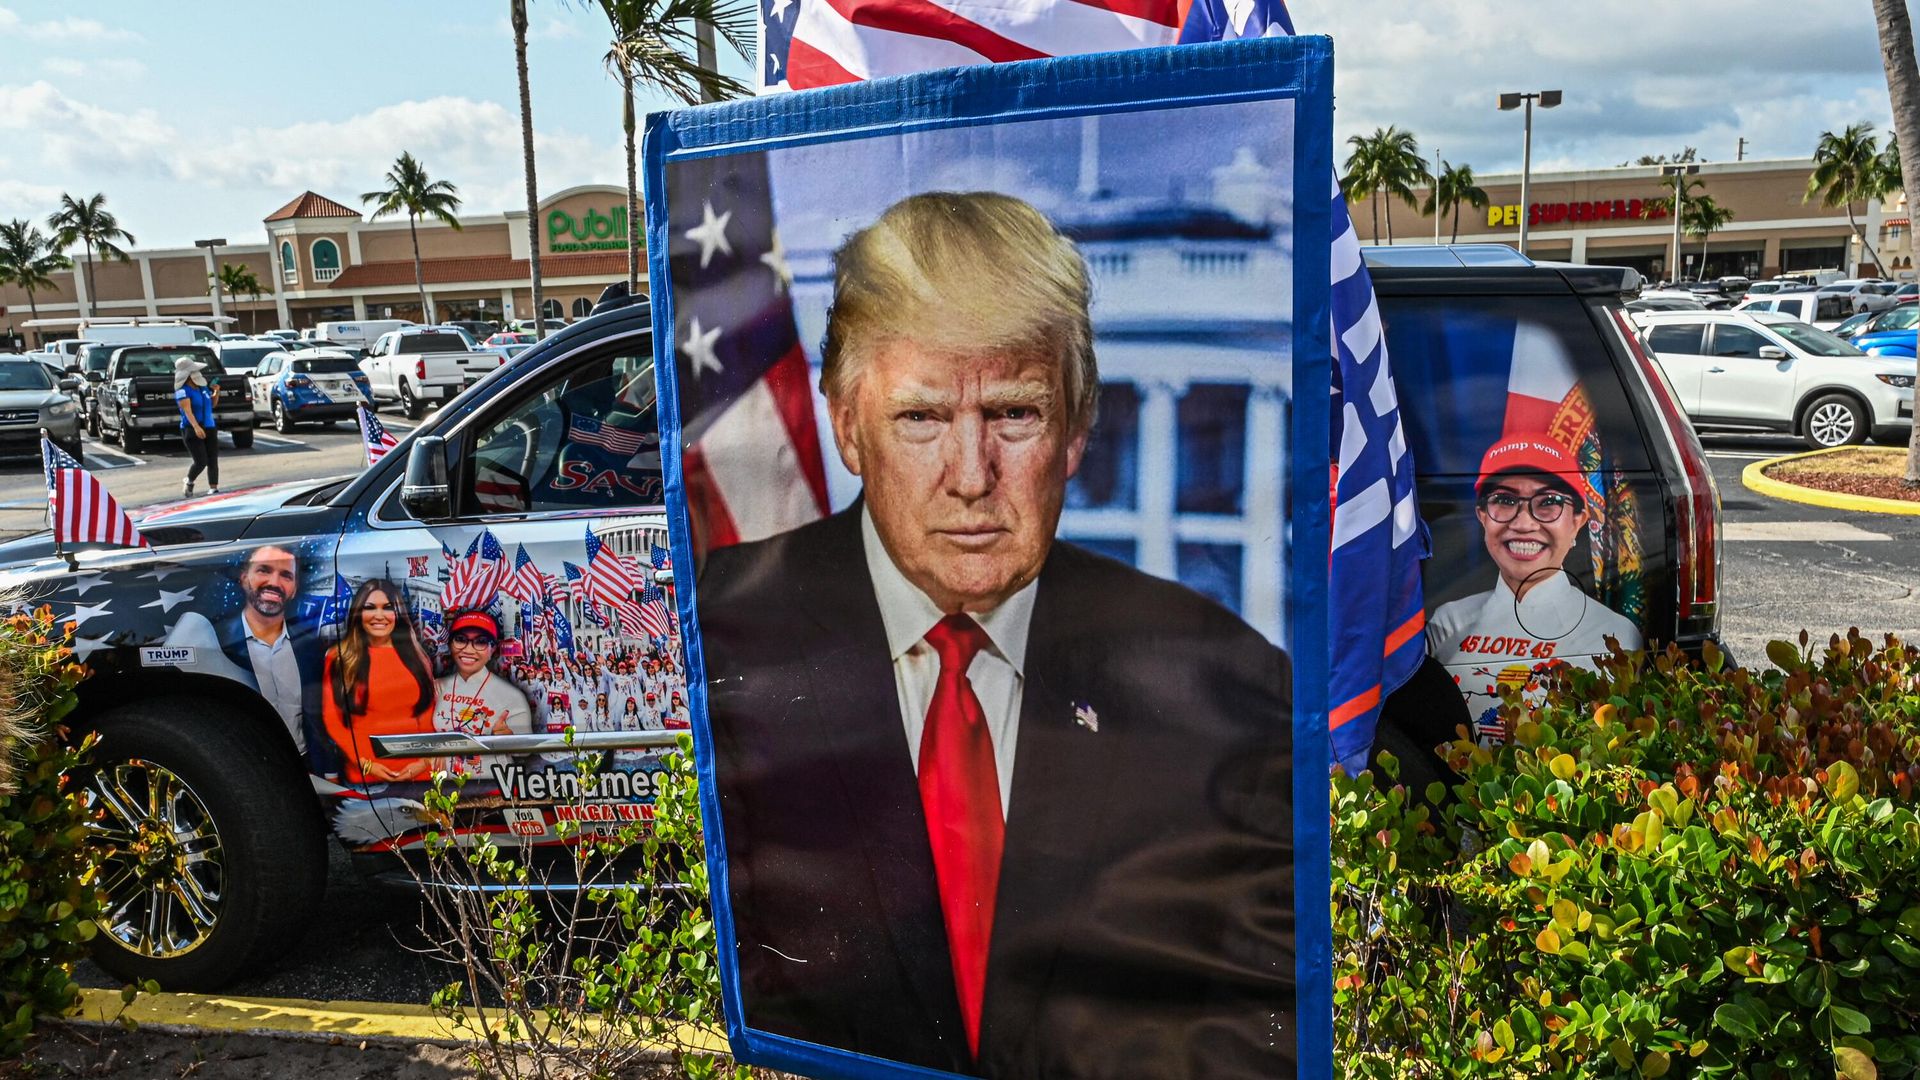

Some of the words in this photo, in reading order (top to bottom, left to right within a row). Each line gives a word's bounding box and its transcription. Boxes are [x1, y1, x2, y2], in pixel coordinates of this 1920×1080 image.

[1530, 199, 1677, 225] SUPERMAR
[1489, 441, 1529, 459] Trump
[1532, 442, 1562, 460] won.
[549, 460, 663, 504] SAV
[147, 650, 189, 659] TRUMP
[1460, 635, 1482, 653] 45
[1479, 636, 1531, 657] LOVE
[1530, 641, 1557, 659] 45
[492, 766, 687, 799] Vietnames
[514, 810, 534, 821] You
[556, 805, 614, 821] MAGA
[618, 804, 659, 821] KIN
